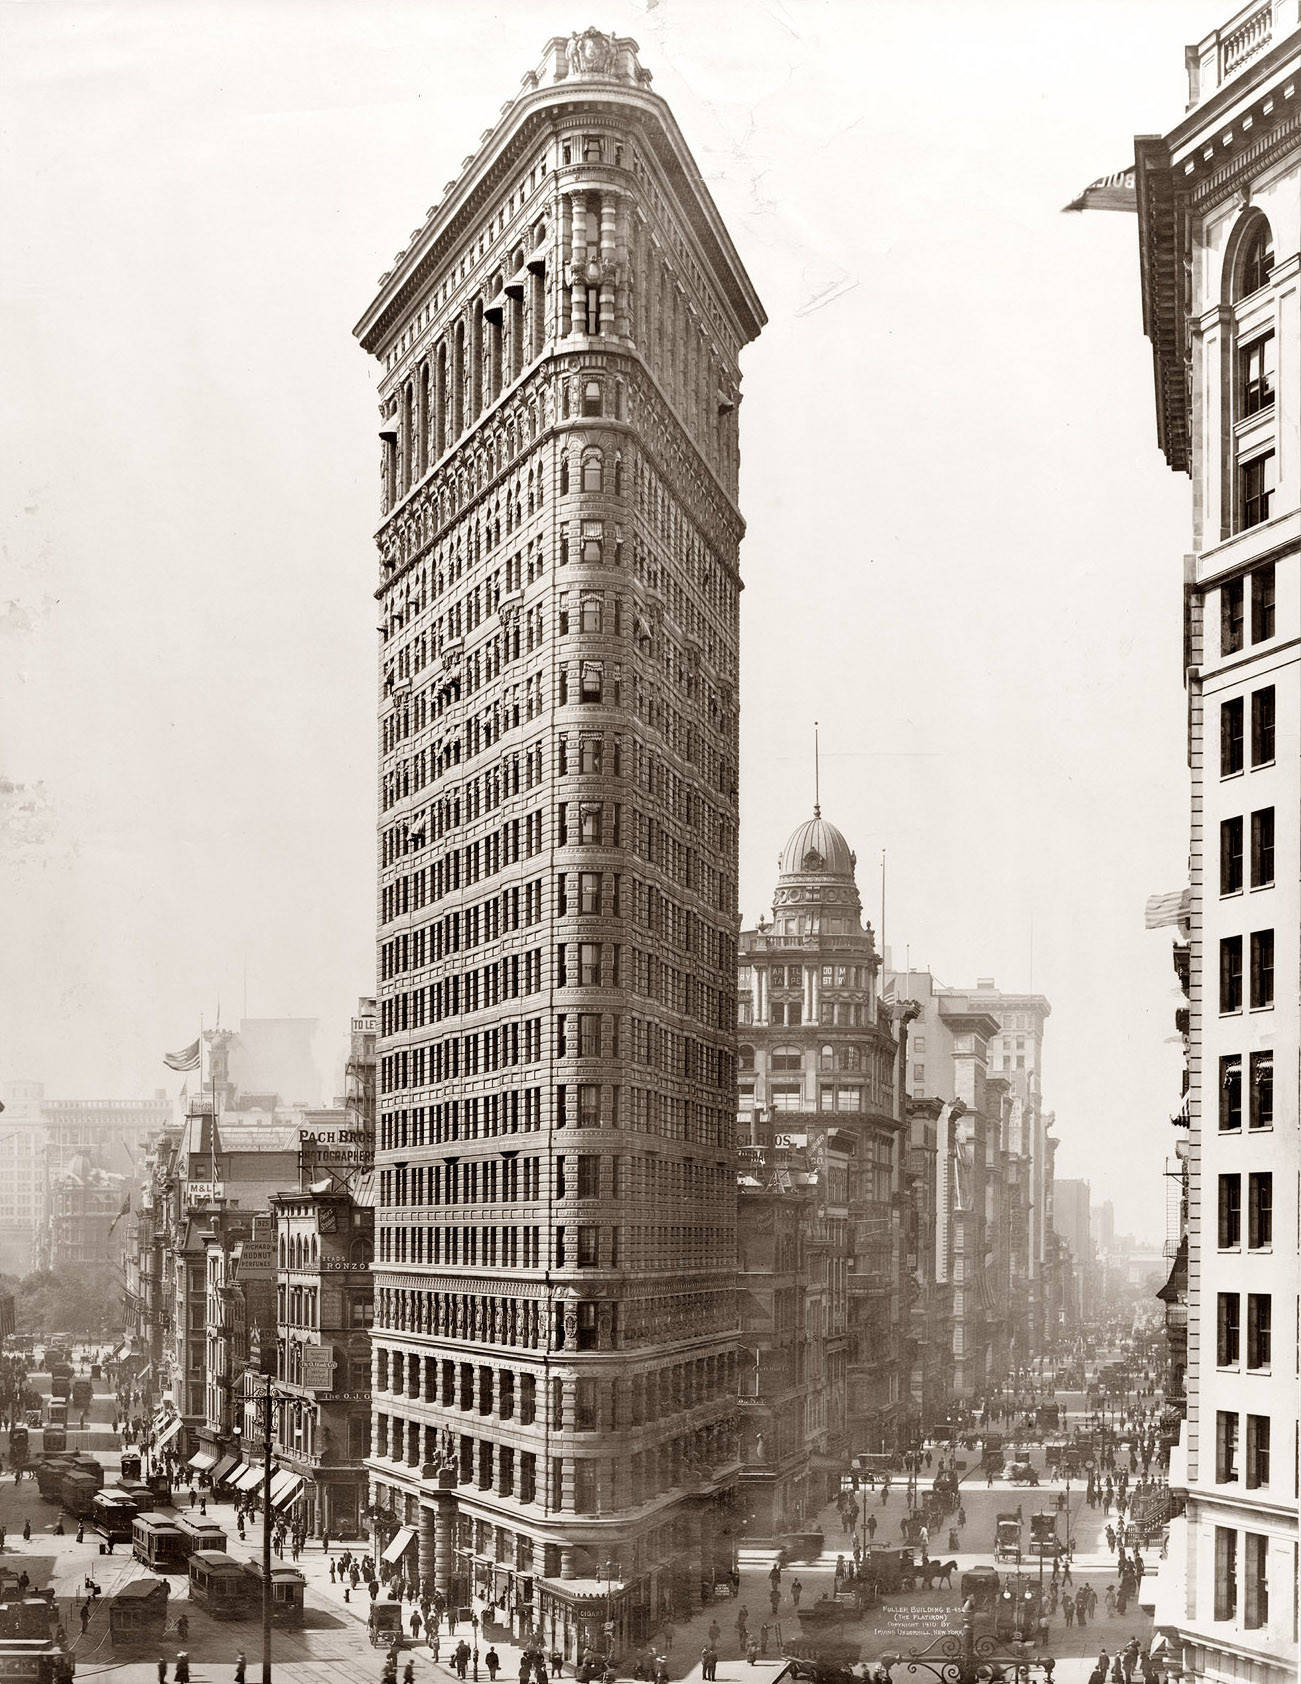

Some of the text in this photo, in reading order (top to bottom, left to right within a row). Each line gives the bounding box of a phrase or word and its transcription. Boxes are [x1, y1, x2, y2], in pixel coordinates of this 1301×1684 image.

[353, 1020, 364, 1030] TO
[298, 1129, 376, 1143] PACH BROS
[298, 1150, 376, 1162] PHOTOGRAPHERS
[243, 1251, 272, 1260] HUDNUT
